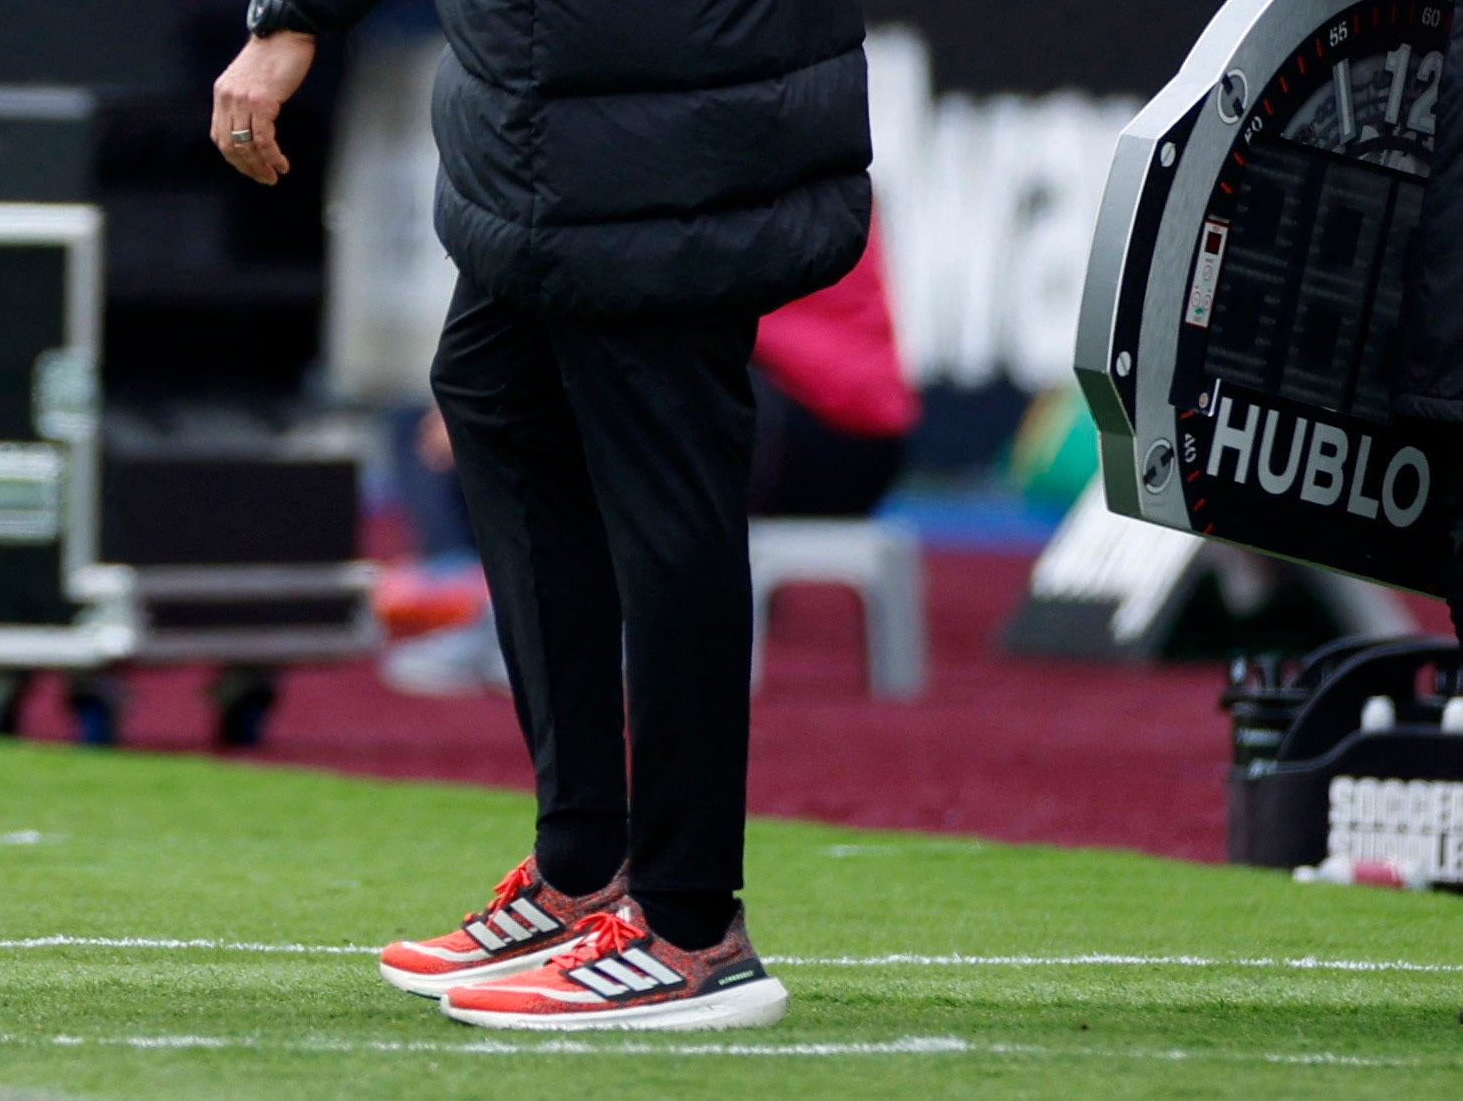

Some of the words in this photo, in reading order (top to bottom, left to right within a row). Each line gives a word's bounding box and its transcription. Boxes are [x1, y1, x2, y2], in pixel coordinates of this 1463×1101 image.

[1422, 7, 1441, 27] 60
[1329, 21, 1348, 47] 55
[1384, 42, 1444, 135] 12
